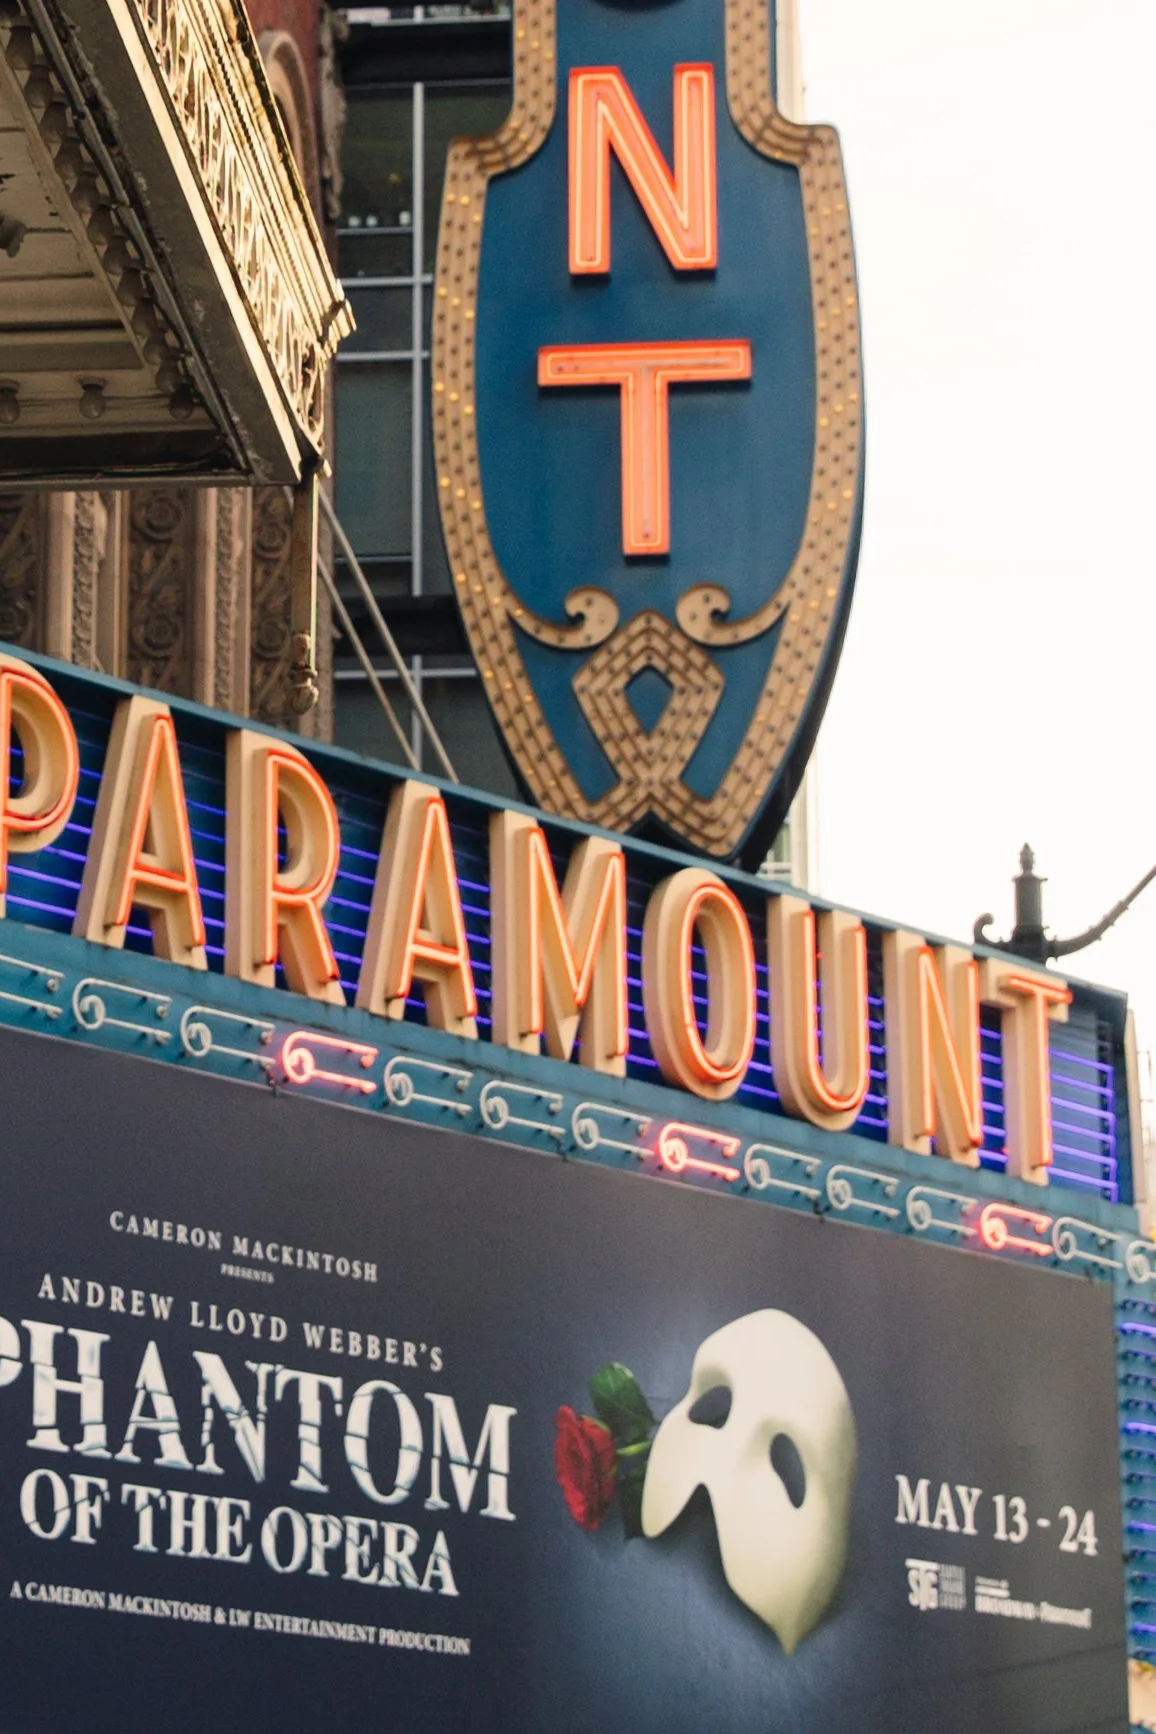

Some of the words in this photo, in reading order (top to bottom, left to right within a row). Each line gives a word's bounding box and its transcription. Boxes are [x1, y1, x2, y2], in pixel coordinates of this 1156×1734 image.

[110, 1211, 222, 1250] CAMERON
[233, 1236, 378, 1282] MACKINTOSH
[220, 1263, 274, 1284] PRESENTS
[39, 1273, 174, 1321] ANDREW
[190, 1301, 288, 1341] LLOYD
[302, 1322, 444, 1371] WEBBER'S
[20, 1468, 110, 1545] OF
[121, 1483, 252, 1564] THE
[261, 1505, 459, 1597] OPERA
[895, 1475, 982, 1536] MAY
[992, 1495, 1027, 1543] 13
[1059, 1506, 1098, 1556] 24
[10, 1581, 23, 1598] A
[26, 1582, 105, 1610] CAMERON
[108, 1592, 211, 1625] MACKINTOSH
[214, 1608, 227, 1626] &
[254, 1612, 376, 1644] ENTERTAINMENT
[379, 1628, 471, 1655] PRODUCTION
